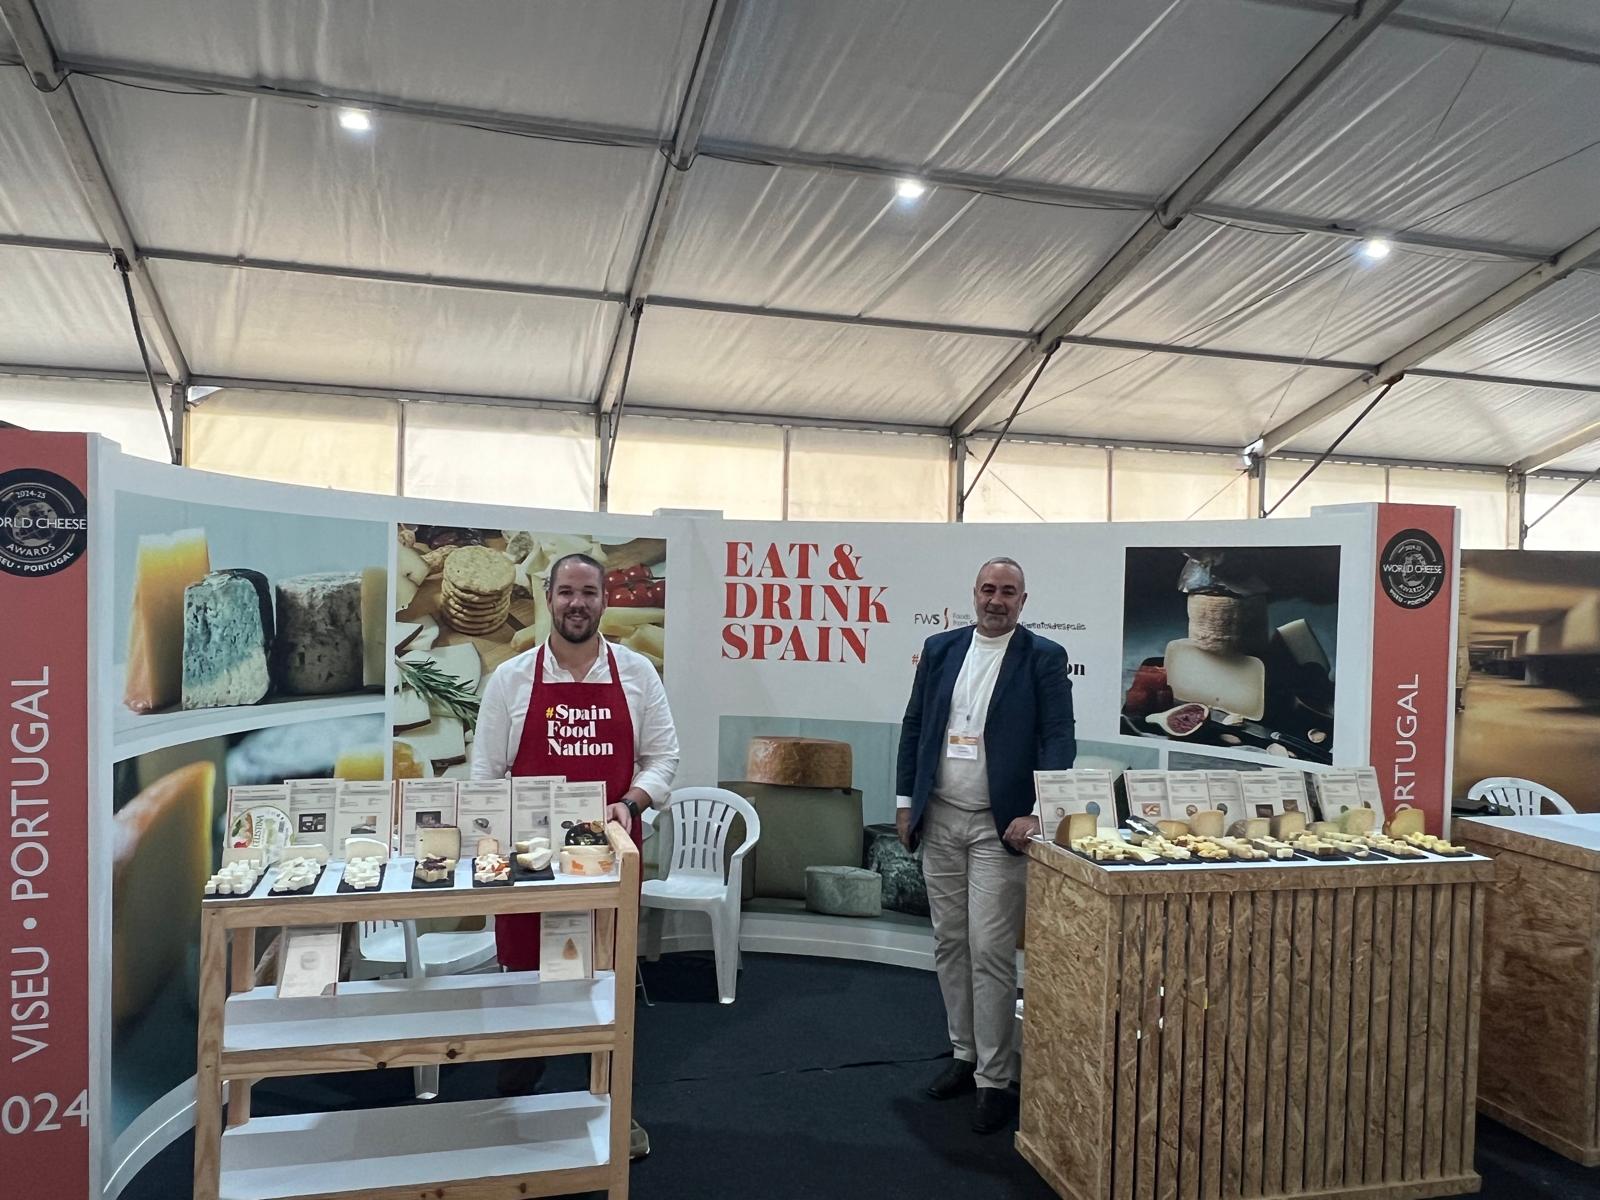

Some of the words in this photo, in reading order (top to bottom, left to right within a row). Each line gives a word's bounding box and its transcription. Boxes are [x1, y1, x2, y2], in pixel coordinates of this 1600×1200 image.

[0, 517, 33, 529] RLD
[36, 517, 88, 530] CHEESE
[6, 543, 56, 557] AWARDS
[723, 541, 820, 579] EAT
[828, 543, 864, 581] &
[23, 551, 74, 572] PORTUGAL
[1382, 564, 1414, 573] WORLD
[1415, 565, 1442, 574] CHEESE
[722, 582, 890, 623] DRINK
[914, 613, 940, 625] FWS
[721, 623, 869, 664] SPAIN
[545, 703, 612, 725] #Spain
[547, 720, 597, 738] Food
[547, 738, 614, 756] Nation
[1393, 673, 1419, 814] RTUGAL
[10, 665, 50, 901] PORTUGAL
[10, 946, 50, 1063] VISEU
[0, 1088, 89, 1135] 024
